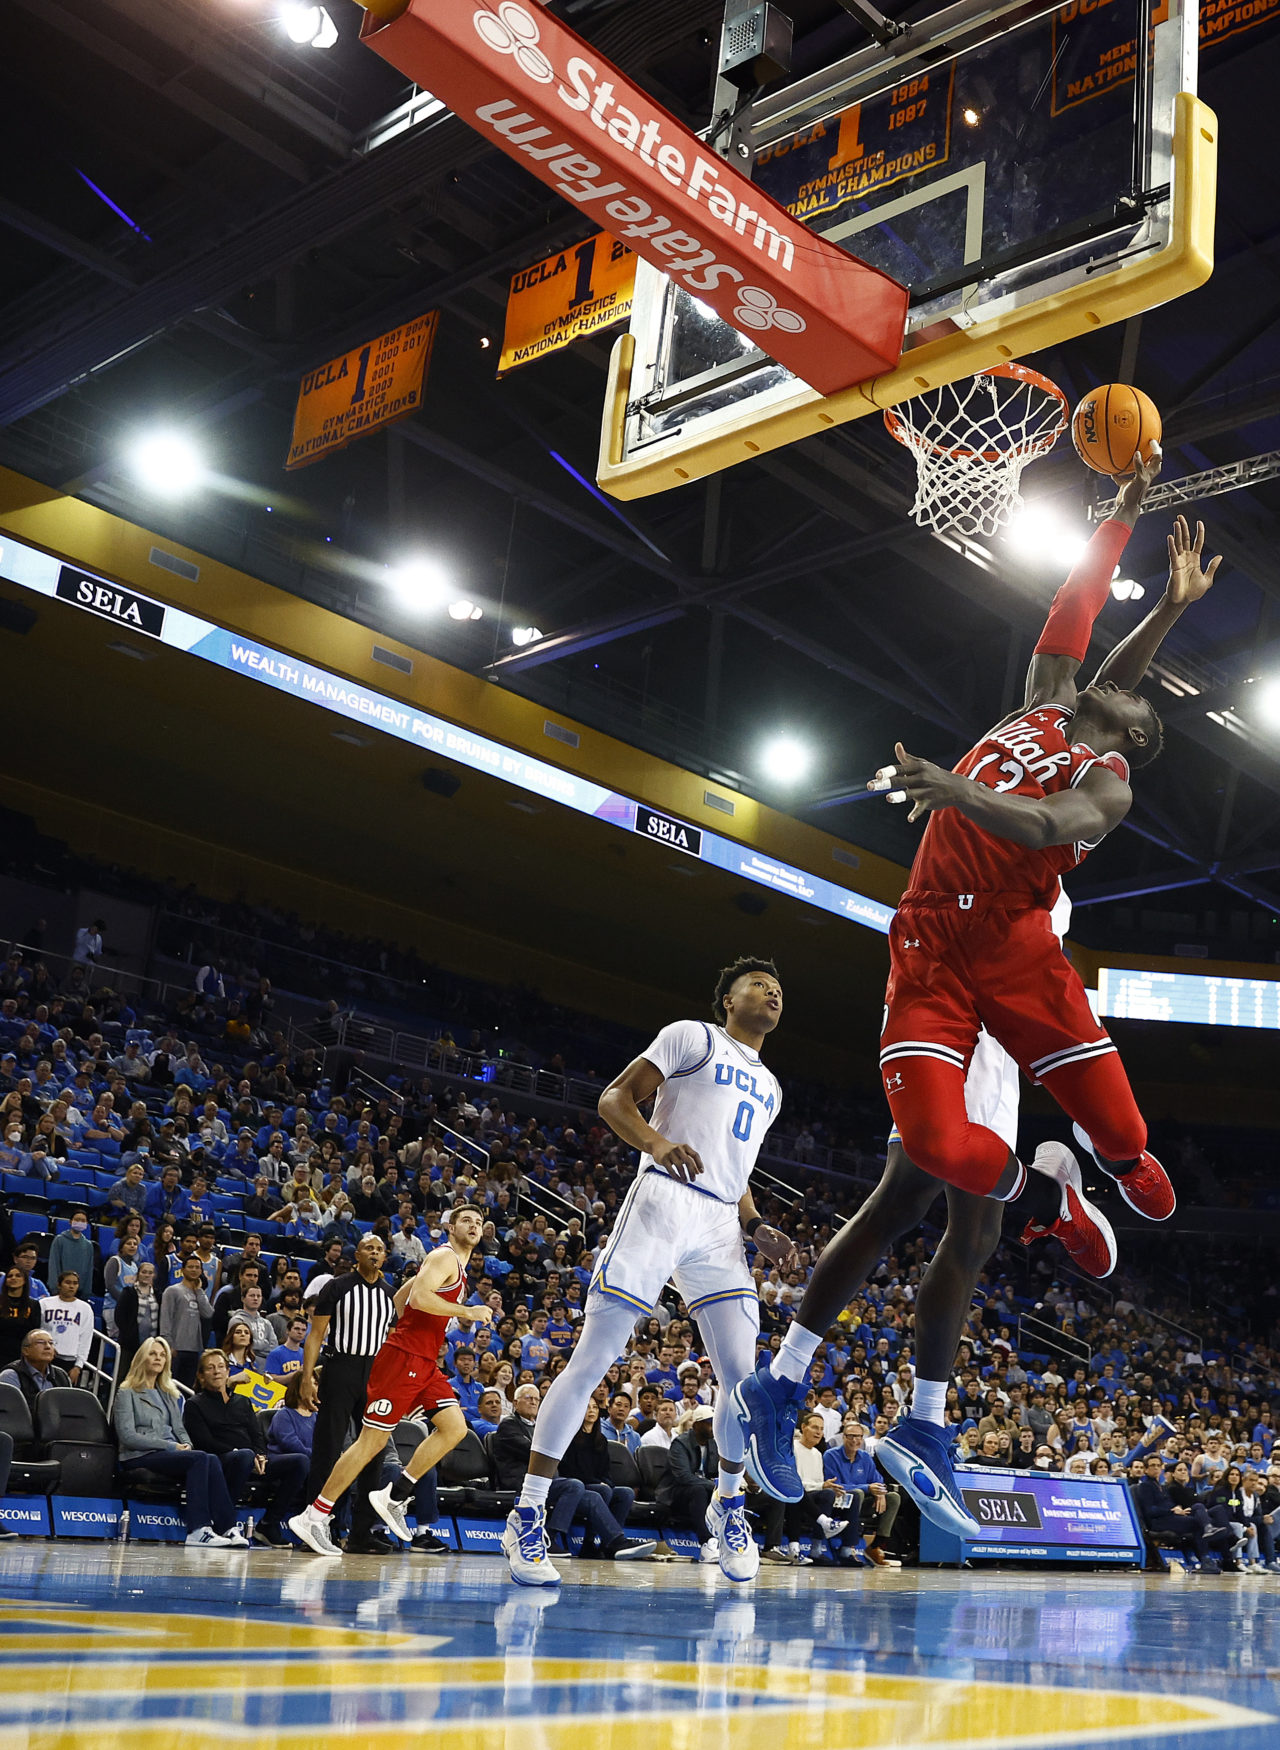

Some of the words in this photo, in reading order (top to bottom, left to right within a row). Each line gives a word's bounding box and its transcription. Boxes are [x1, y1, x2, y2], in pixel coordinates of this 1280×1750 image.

[891, 75, 930, 106] 1984
[888, 100, 928, 131] 1987
[798, 150, 886, 199] GYMNASTICS
[837, 142, 937, 198] CHAMPIONS
[512, 253, 567, 294] UCLA
[568, 239, 597, 310] 1
[544, 292, 618, 335] GYMNASTICS
[513, 330, 570, 362] NATIONAL
[302, 358, 350, 396] UCLA
[349, 346, 371, 405] 1
[322, 393, 387, 430] GYMNASTICS
[1084, 400, 1099, 444] NCAA
[291, 425, 346, 458] NATIONAL
[76, 580, 144, 626] SEIA
[231, 644, 299, 685] WEALTH
[302, 674, 411, 730] MANAGEMENT
[412, 719, 444, 745] FOR
[446, 733, 501, 767] BRUINS
[503, 756, 523, 776] BY
[524, 765, 576, 798] BRUINS
[989, 722, 1071, 789] Utah
[647, 816, 689, 849] SEIA
[715, 1063, 775, 1121] UCLA
[732, 1100, 755, 1142] 0
[44, 1309, 82, 1325] UCLA
[61, 1510, 107, 1522] WESCOM
[137, 1514, 181, 1527] WESCOM
[979, 1498, 1028, 1523] SEIA
[465, 1529, 499, 1541] WESCOM
